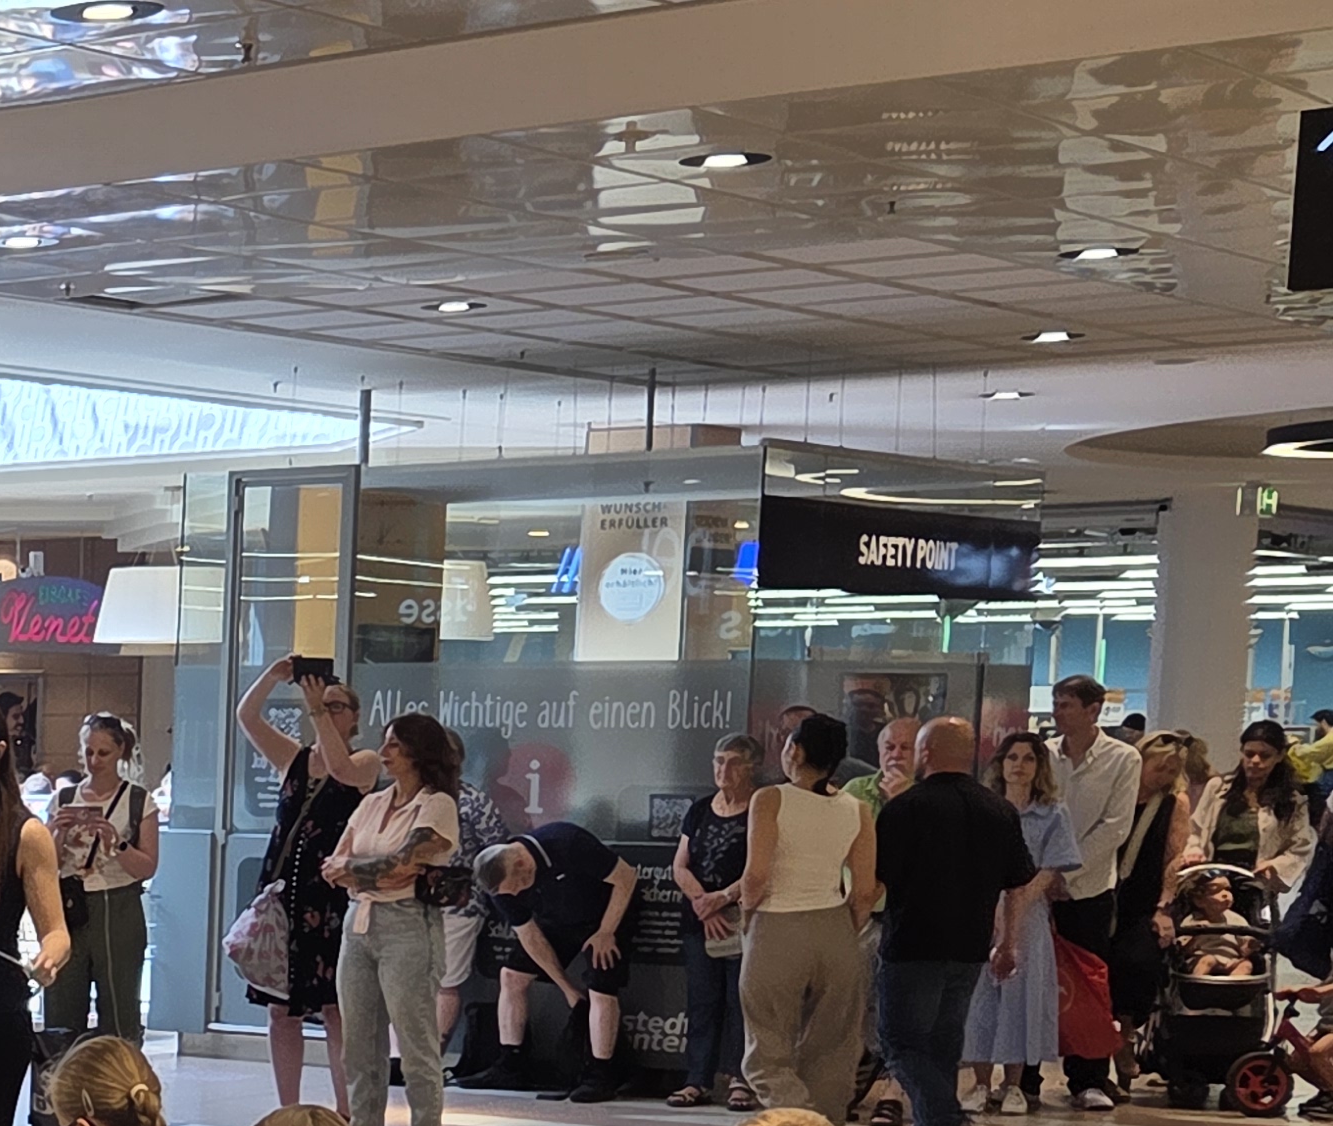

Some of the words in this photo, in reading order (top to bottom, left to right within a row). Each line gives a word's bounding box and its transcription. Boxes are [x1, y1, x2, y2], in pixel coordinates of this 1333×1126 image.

[600, 516, 669, 531] ERFÜLLER
[858, 533, 915, 569] SAFETY
[915, 538, 959, 571] POINT
[0, 588, 99, 644] Venet
[369, 689, 429, 727] Alles
[439, 689, 528, 739] Wichtige
[537, 690, 579, 728] auf
[589, 700, 656, 728] einen
[667, 689, 733, 730] Blick!
